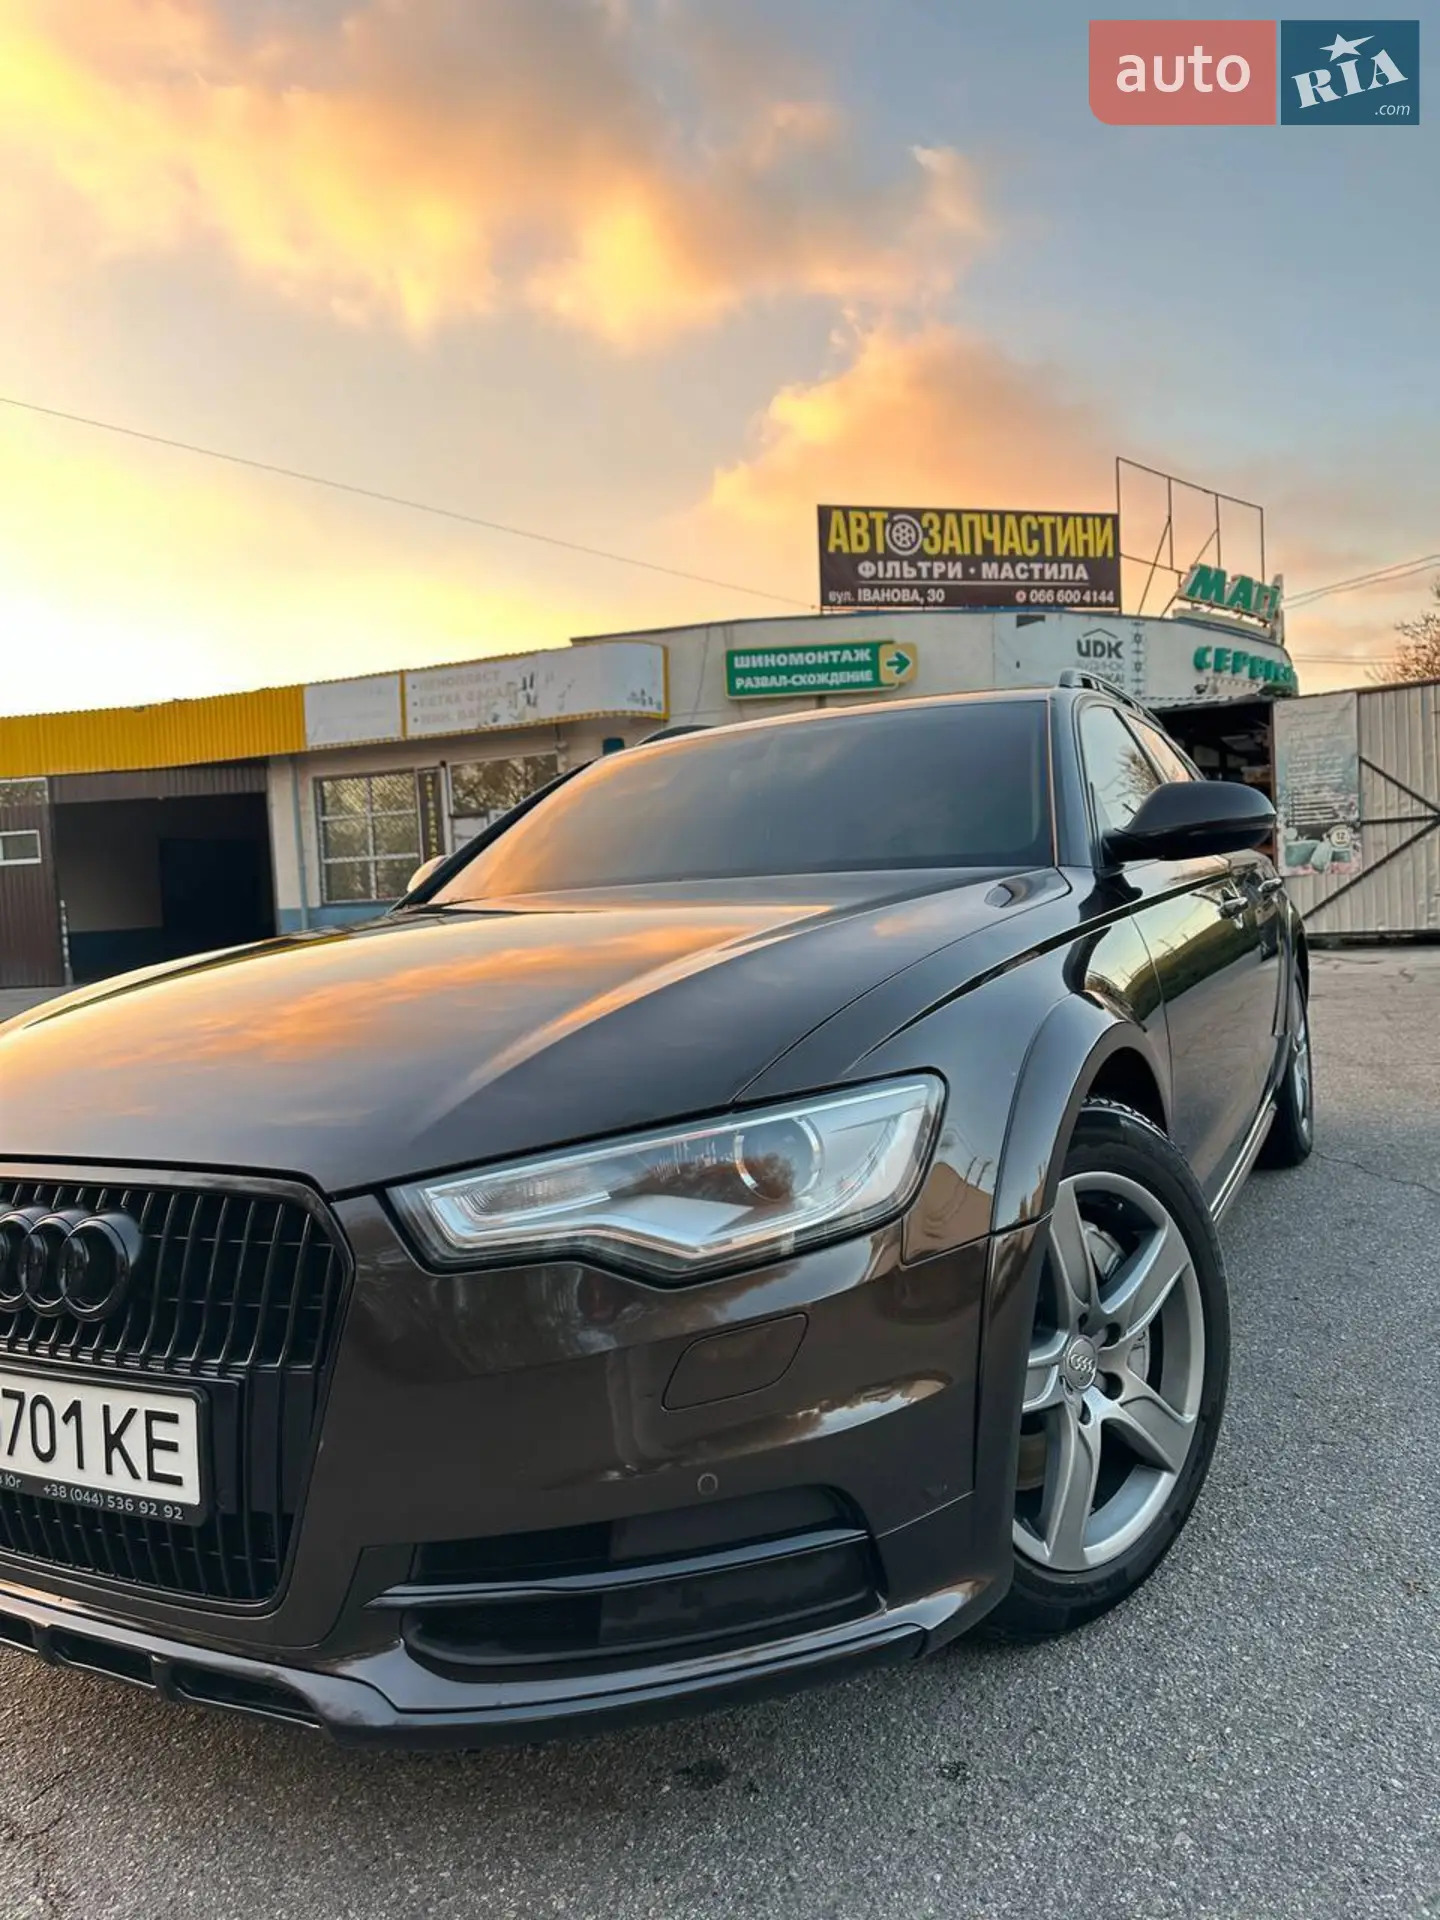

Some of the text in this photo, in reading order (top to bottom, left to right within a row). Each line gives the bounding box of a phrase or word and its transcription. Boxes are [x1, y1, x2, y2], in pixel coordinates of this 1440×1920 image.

[857, 560, 1089, 581] ФІЛЬТРИ МАСТИЛА
[828, 587, 945, 605] вул. ІВАНОВА, 30
[1029, 589, 1114, 603] 066 600 4144
[734, 648, 872, 668] ШИНОМОНТАЖ
[1076, 639, 1124, 660] UDK
[735, 669, 873, 690] РАЗВАЛ-СХОЖДЕНИЕ
[102, 1404, 184, 1486] KE
[43, 1483, 184, 1521] +38 (044) 536 92 92
